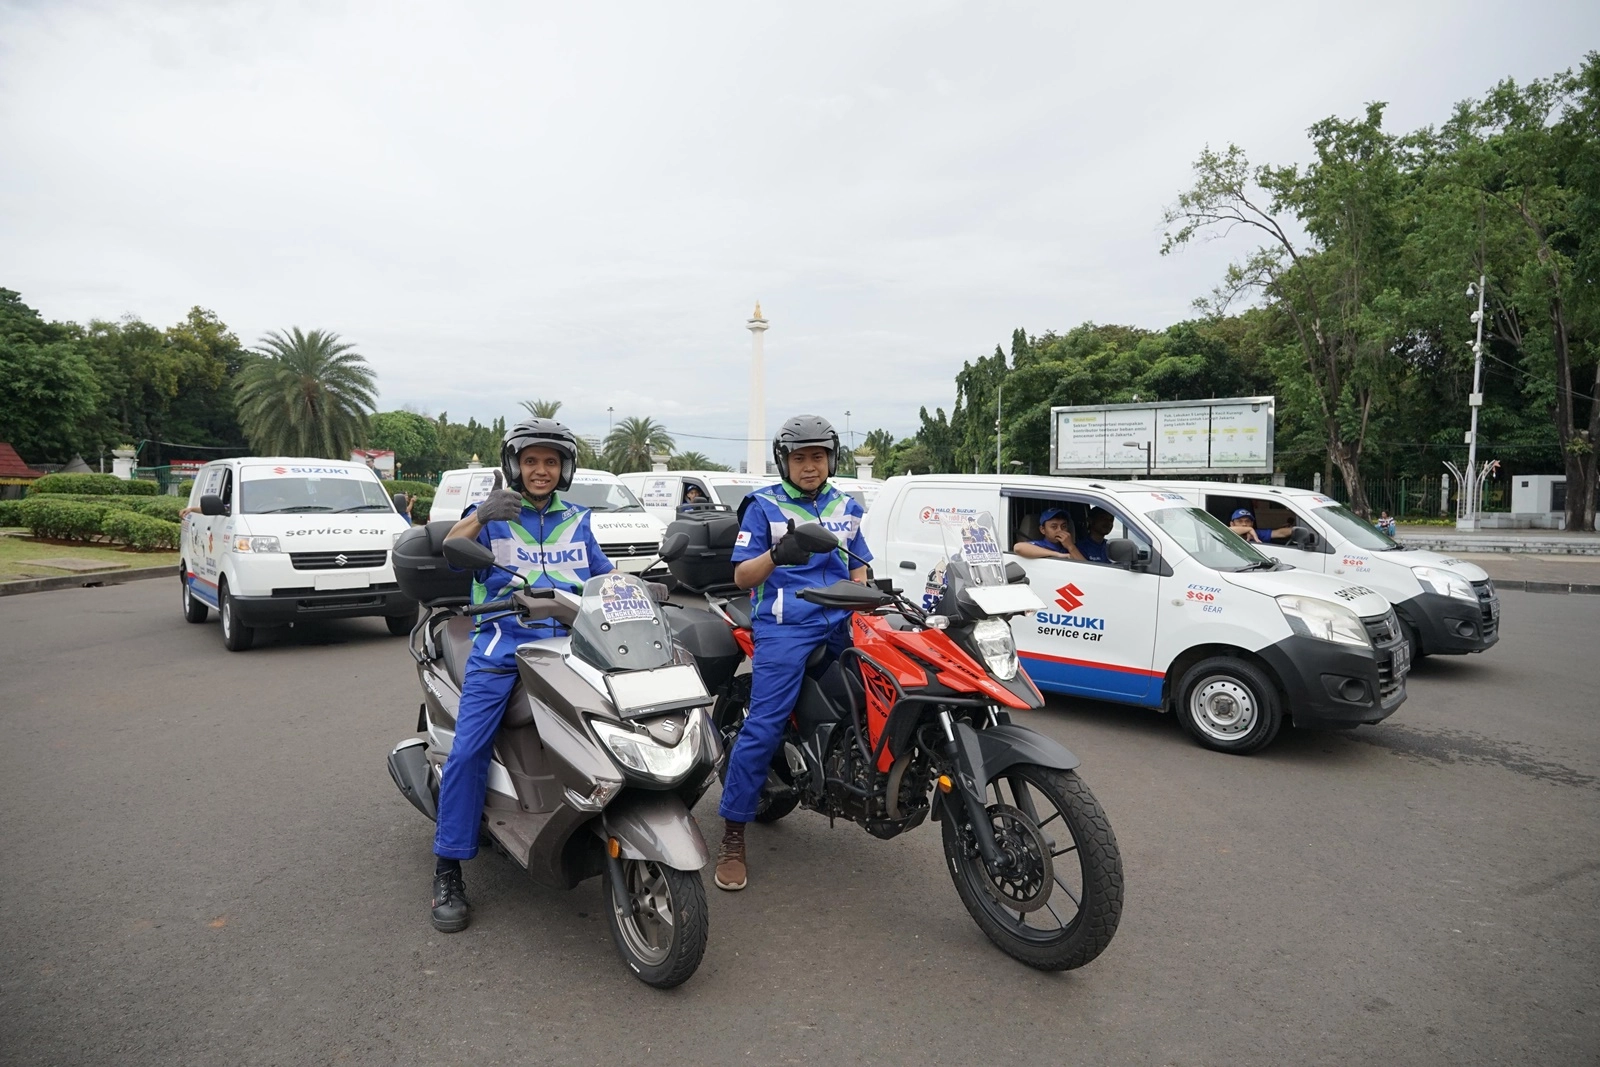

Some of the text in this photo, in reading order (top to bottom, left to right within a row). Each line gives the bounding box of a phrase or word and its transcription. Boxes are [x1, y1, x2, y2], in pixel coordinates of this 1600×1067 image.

[291, 467, 349, 475] SUZUKI
[598, 520, 632, 530] service
[822, 520, 853, 532] UKI
[285, 527, 353, 537] service
[964, 543, 998, 554] SUZUKI
[516, 547, 584, 564] SUZUKI
[1187, 583, 1222, 593] ECSTAR
[602, 600, 650, 613] SUZUKI
[1202, 604, 1223, 614] GEAR
[1036, 612, 1105, 631] SUZUKI
[1037, 625, 1104, 642] service car
[980, 679, 1000, 693] SX
